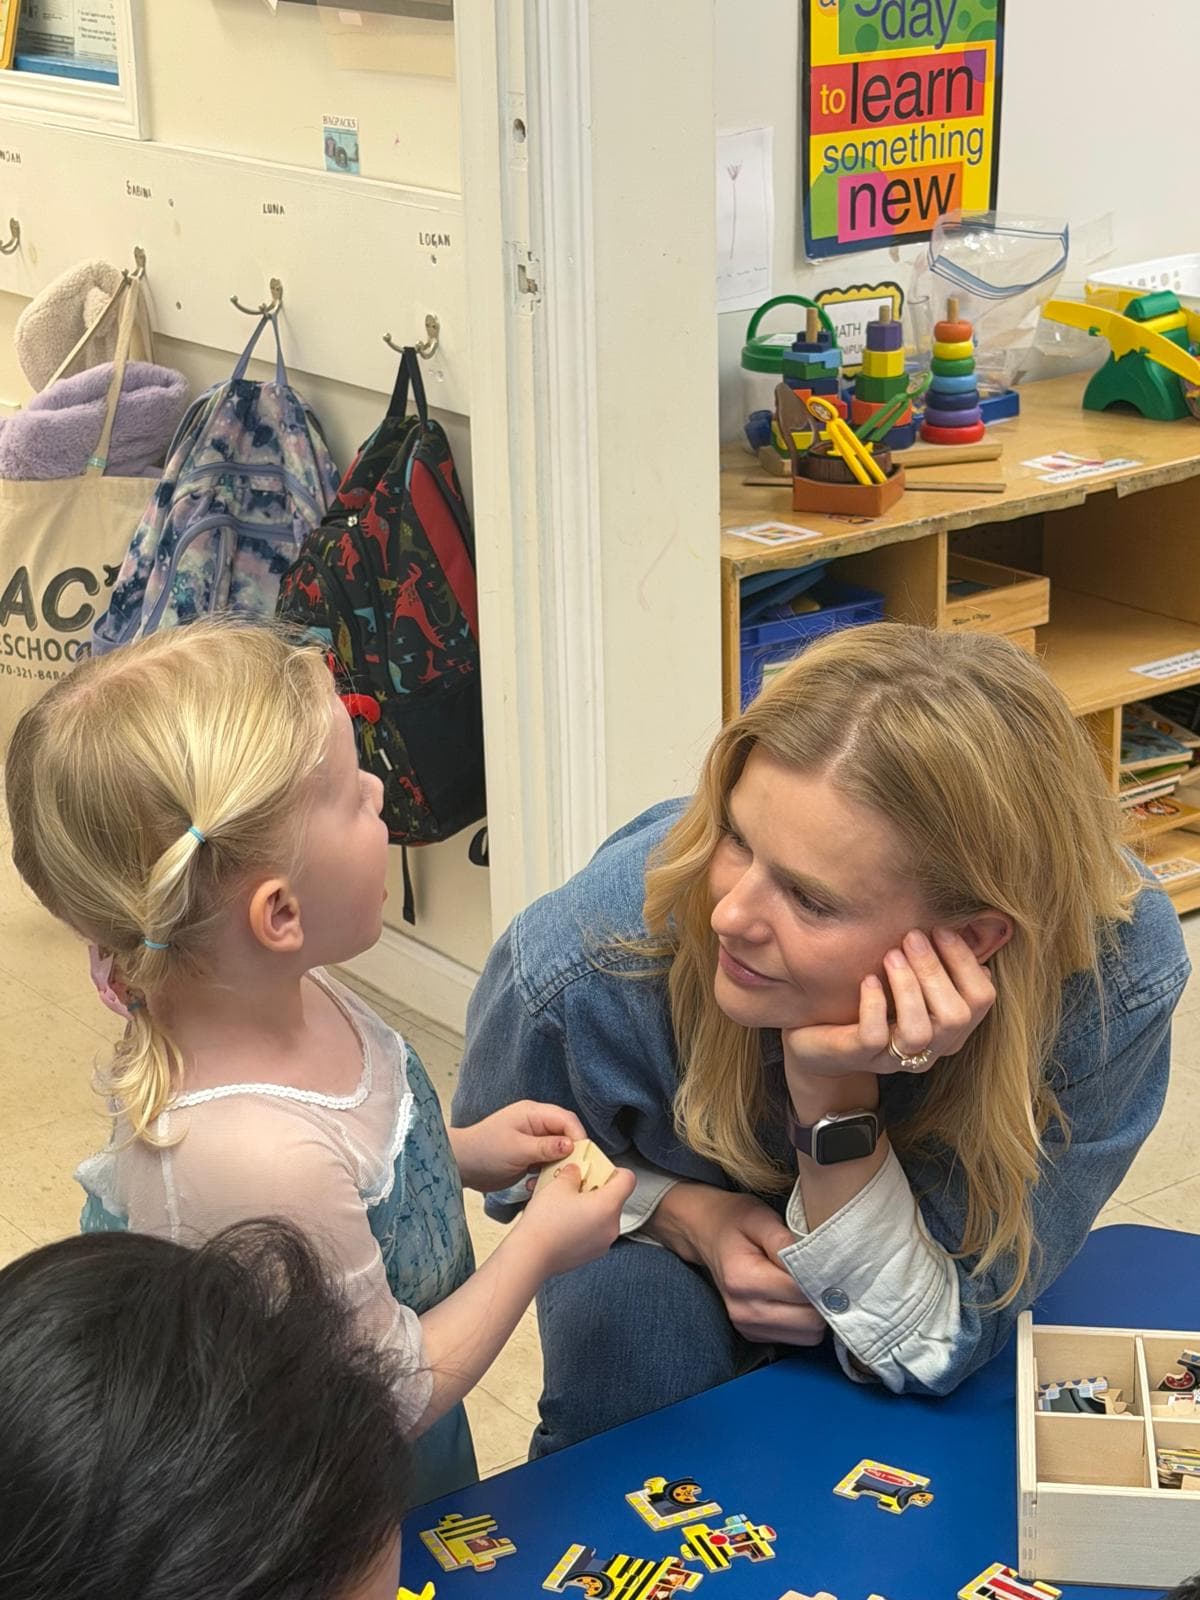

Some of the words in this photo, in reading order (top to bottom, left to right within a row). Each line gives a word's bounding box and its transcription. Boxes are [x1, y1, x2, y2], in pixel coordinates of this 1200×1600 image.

[880, 0, 957, 50] day
[820, 84, 846, 115] to
[851, 62, 973, 124] learn
[823, 123, 984, 174] something
[263, 203, 285, 215] LUNA
[850, 173, 956, 231] new
[419, 231, 451, 248] LOGAN
